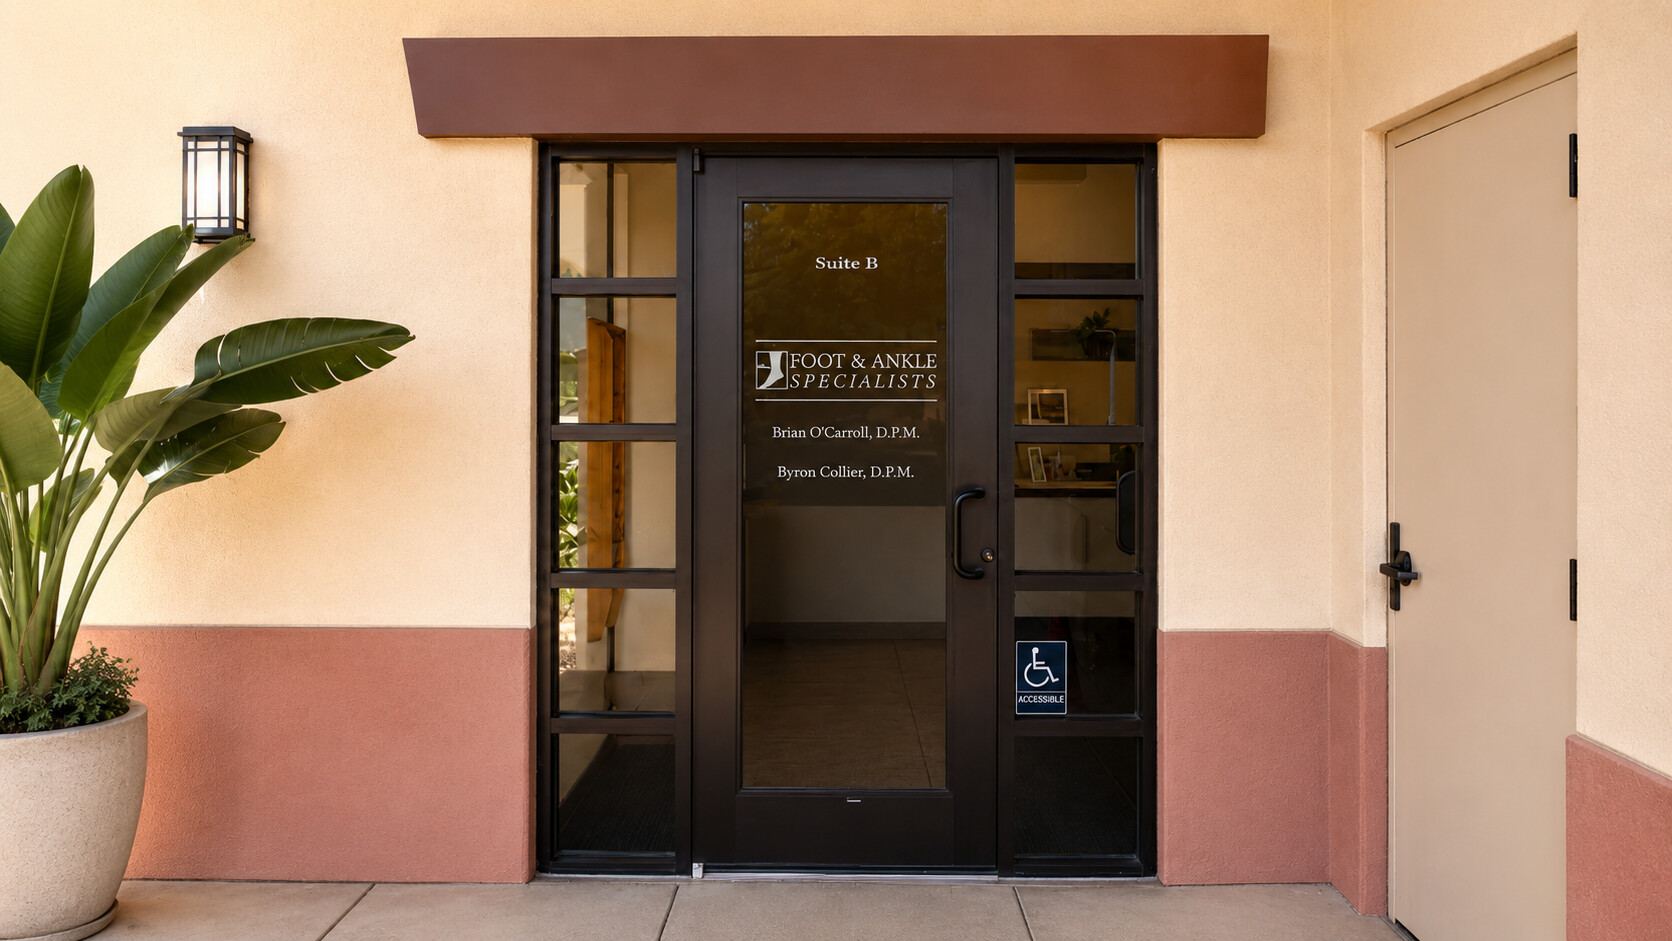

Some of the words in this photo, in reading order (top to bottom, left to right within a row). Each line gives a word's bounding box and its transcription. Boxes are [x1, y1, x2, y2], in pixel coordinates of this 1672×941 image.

[816, 256, 860, 270] Suite
[865, 257, 878, 269] B
[790, 353, 846, 369] FOOT
[851, 353, 866, 369] &
[871, 353, 938, 369] ANKLE
[790, 374, 937, 389] SPECIALISTS
[772, 426, 806, 439] Brian
[810, 426, 873, 440] O'Carroll,
[876, 426, 920, 439] D.P.M.
[777, 466, 816, 481] Byron
[820, 466, 867, 480] Collier,
[870, 466, 915, 478] D.P.M.
[1018, 695, 1064, 704] ACCESSIBLE
